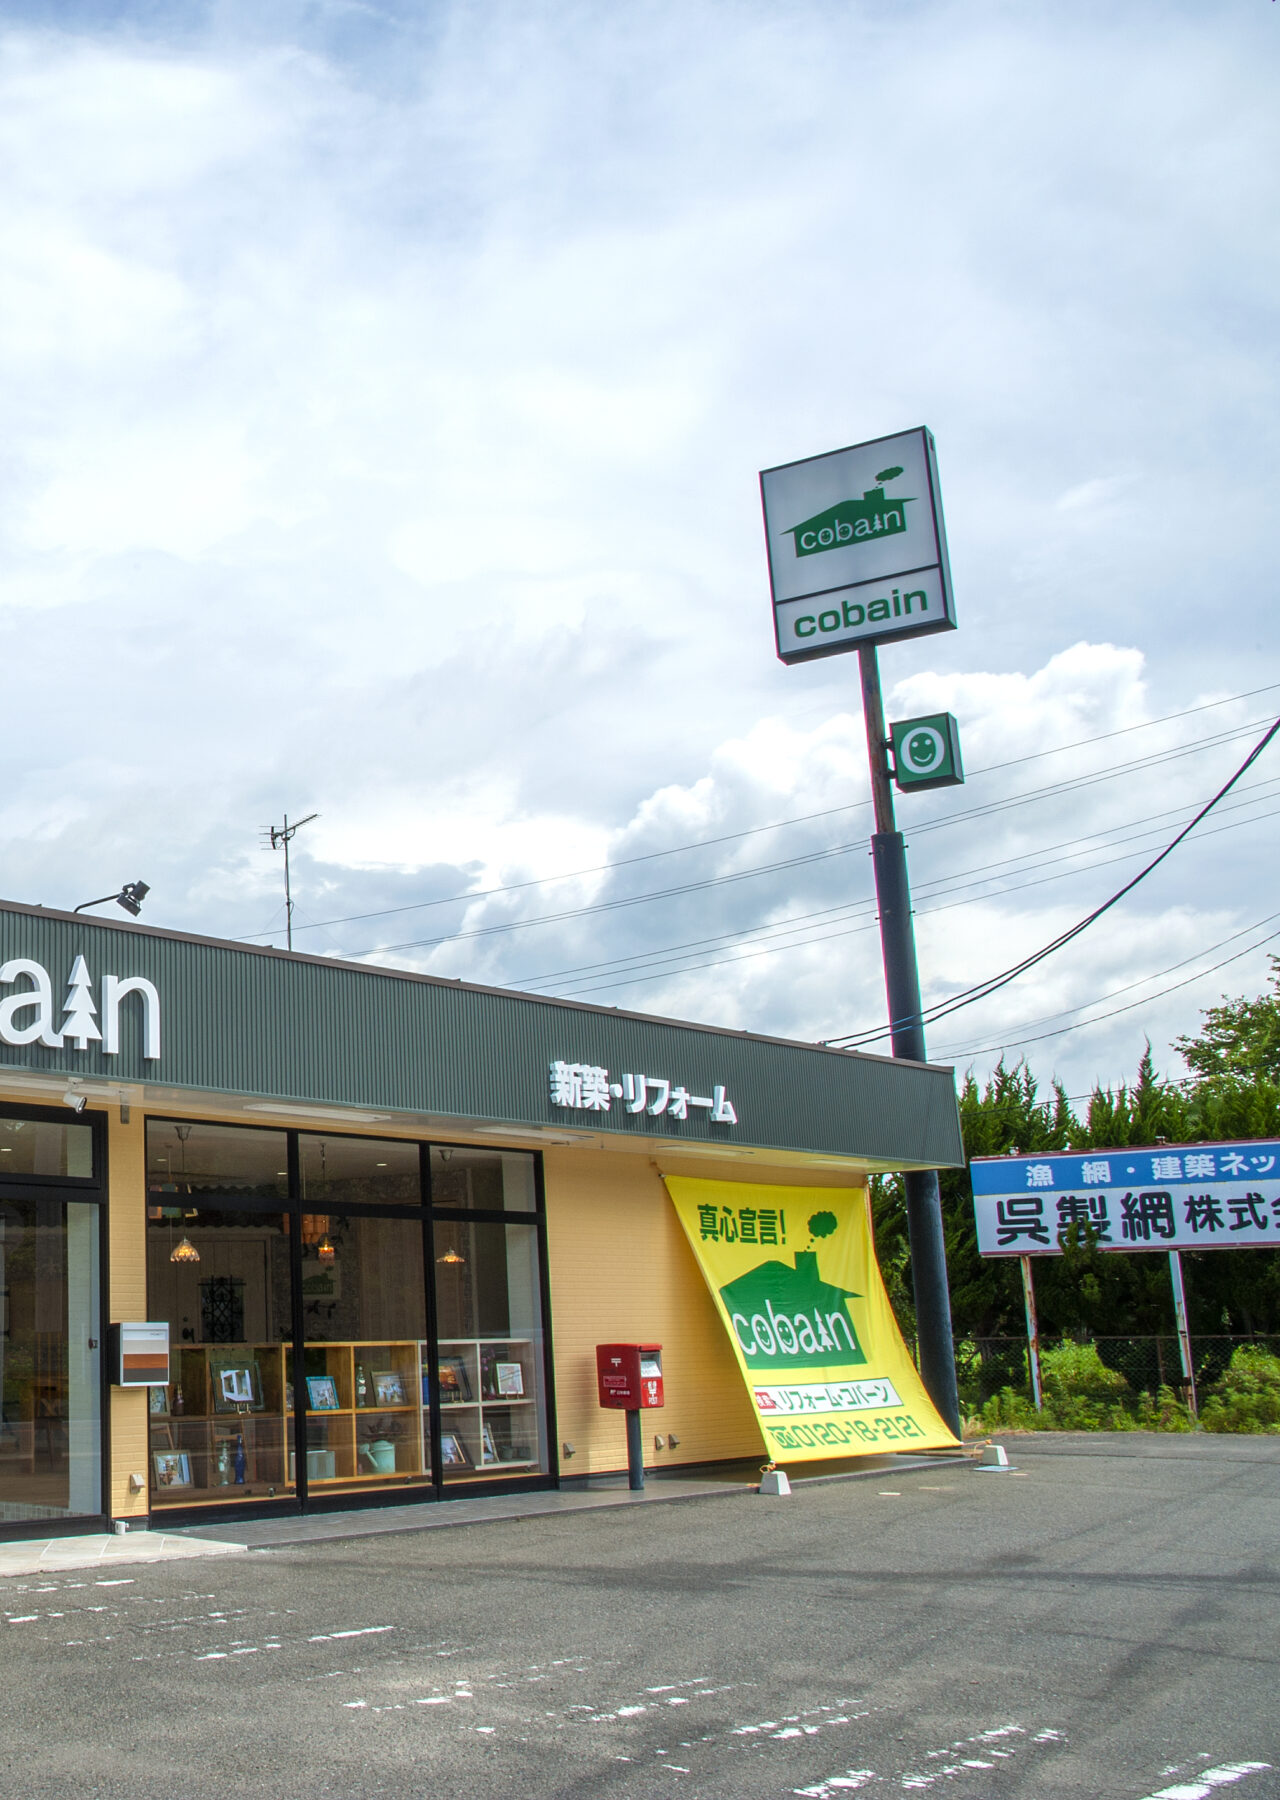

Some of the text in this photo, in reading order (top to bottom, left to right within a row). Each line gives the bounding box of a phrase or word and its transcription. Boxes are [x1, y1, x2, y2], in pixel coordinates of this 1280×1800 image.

[799, 508, 901, 552] cobain
[794, 588, 928, 638] cobain
[550, 1061, 738, 1125] 新築・リフォーム
[697, 1203, 787, 1245] 真心宣言!
[731, 1299, 857, 1356] cobain
[791, 1415, 927, 1448] 0120-18-2121
